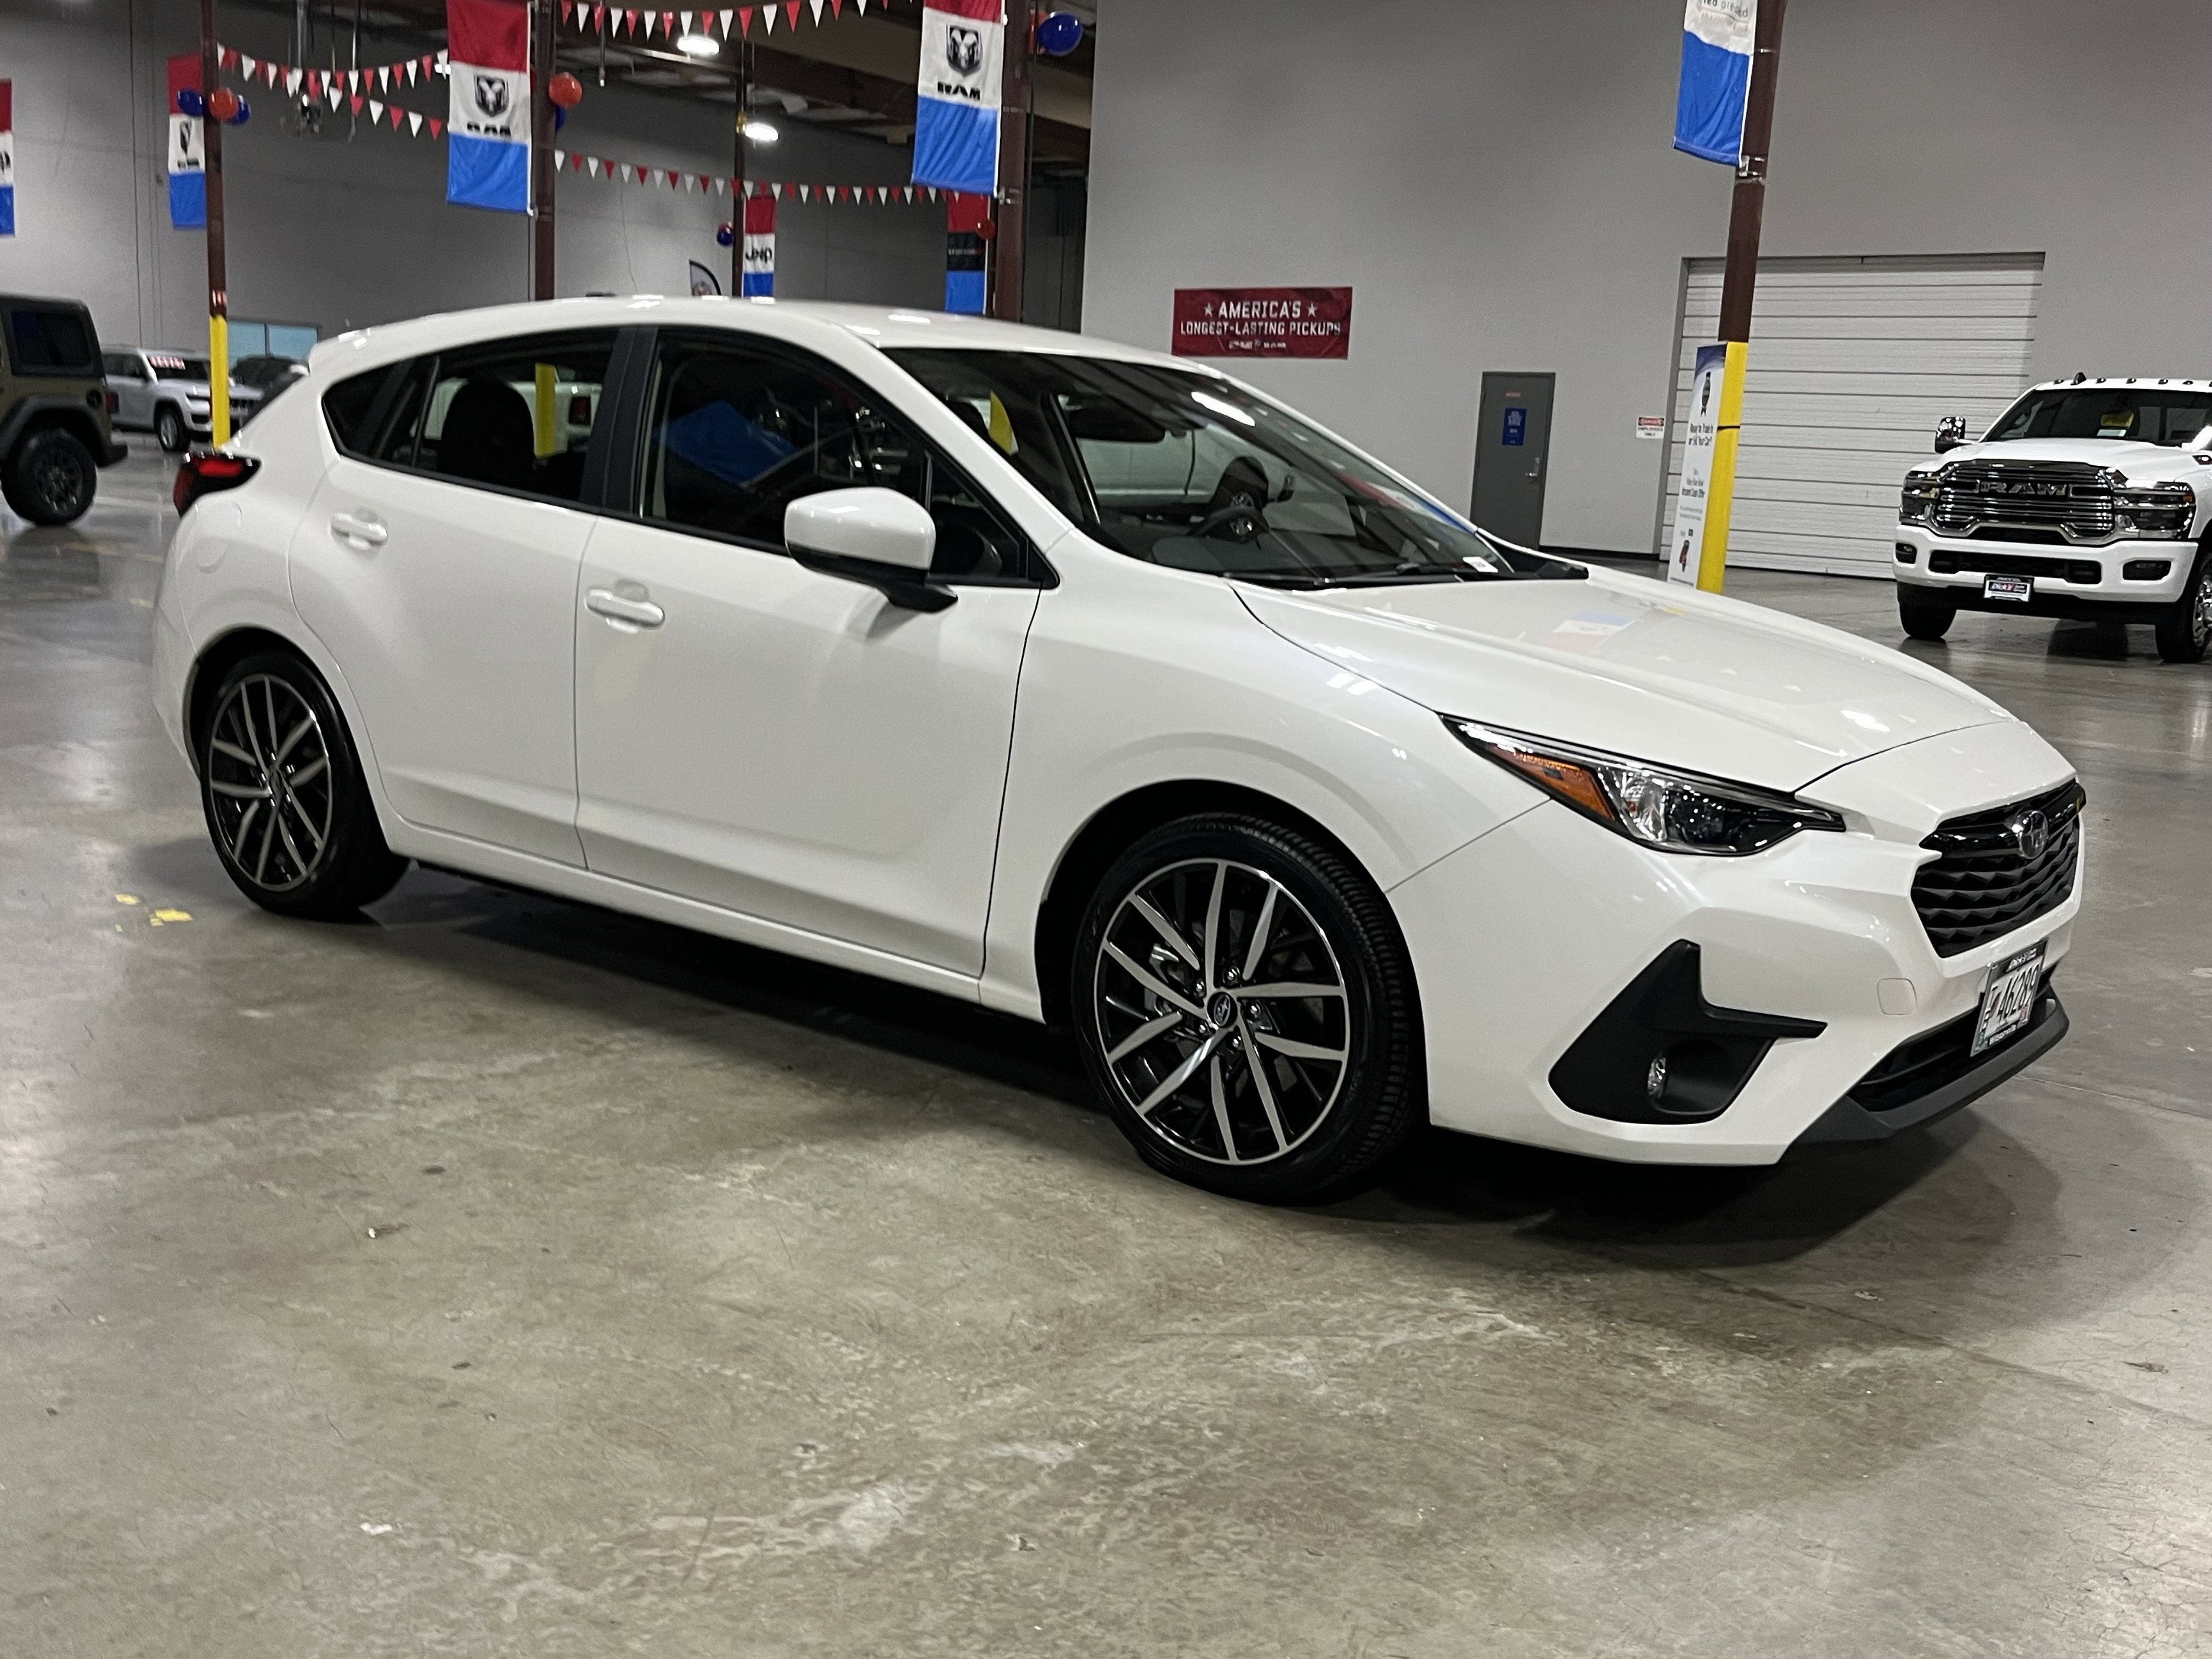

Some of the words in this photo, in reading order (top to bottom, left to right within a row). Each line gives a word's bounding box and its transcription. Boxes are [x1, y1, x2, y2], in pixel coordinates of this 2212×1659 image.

[937, 82, 980, 101] RAM
[1218, 300, 1301, 318] AMERICA'S
[1180, 321, 1285, 336] LONGEST-LASTING
[1289, 321, 1341, 336] PICKUPS
[1980, 481, 2067, 495] RAM
